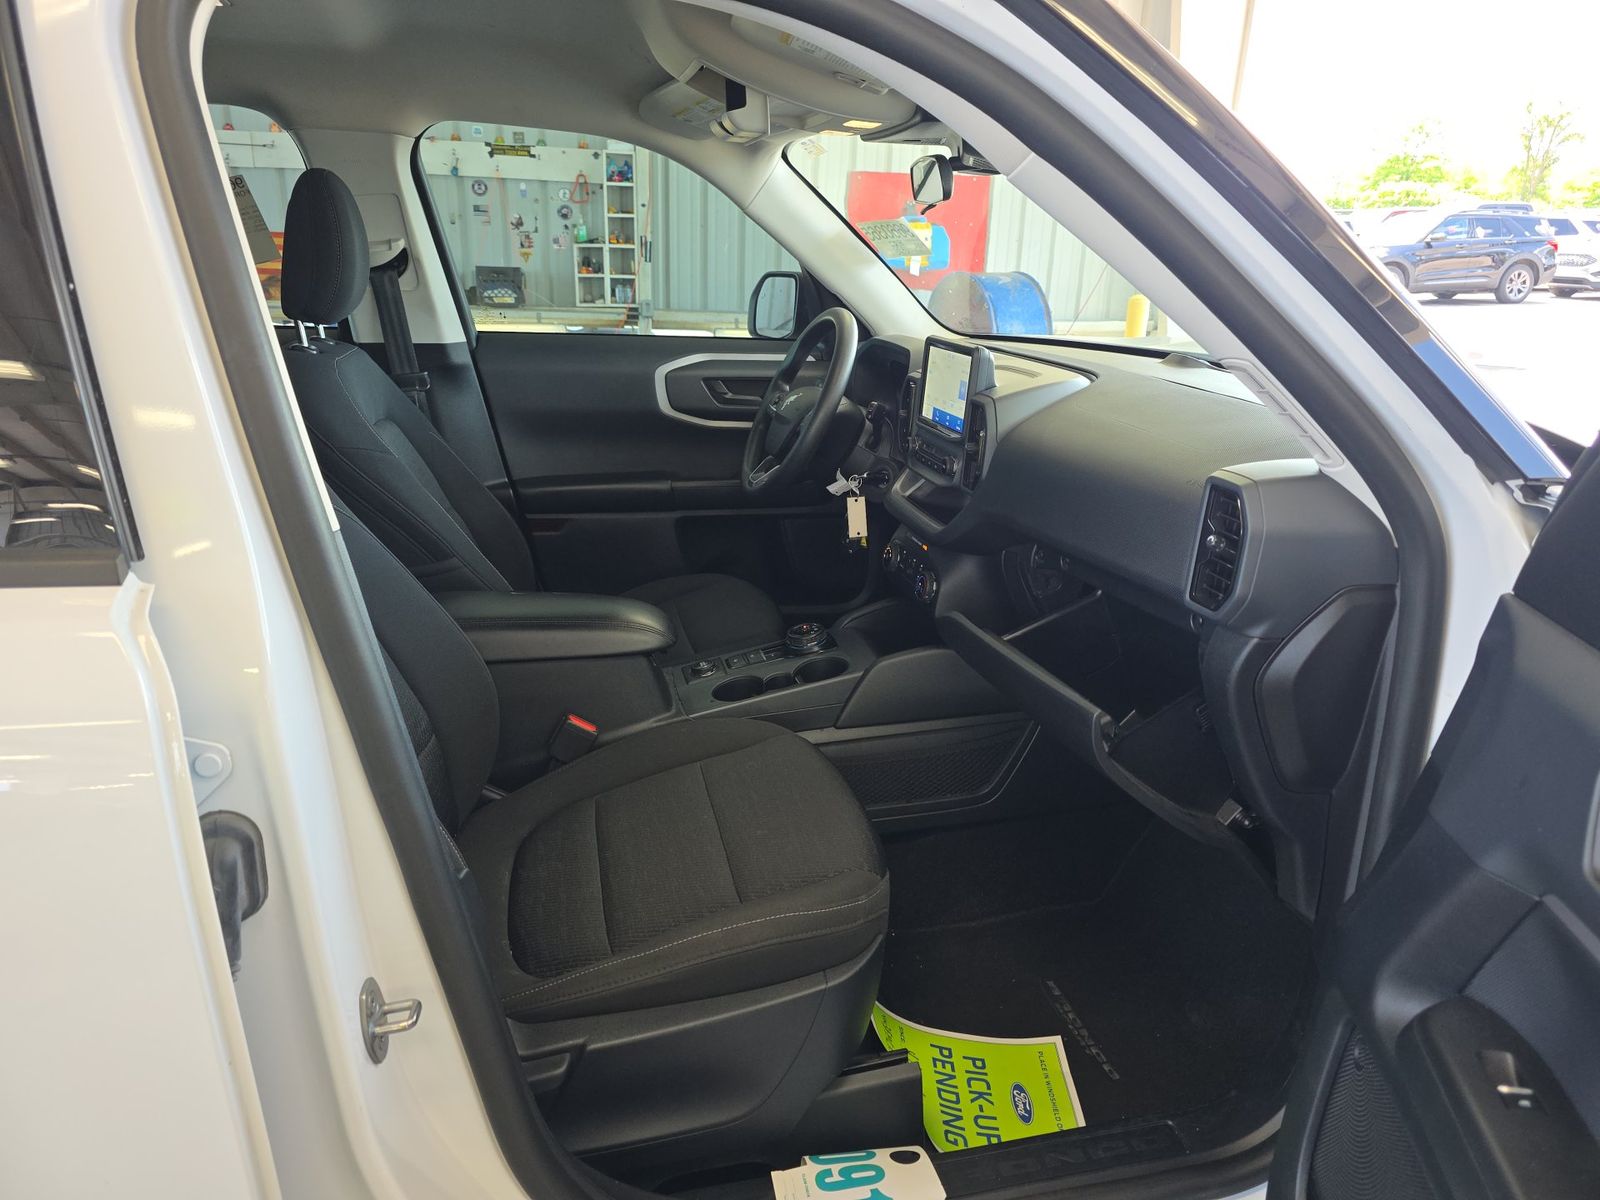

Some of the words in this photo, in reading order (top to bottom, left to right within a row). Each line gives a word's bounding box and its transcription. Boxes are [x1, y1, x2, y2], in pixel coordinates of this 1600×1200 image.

[929, 1042, 969, 1148] PENDING
[1012, 1088, 1033, 1123] Ford
[1037, 1050, 1048, 1072] PLACE
[1044, 1080, 1061, 1123] WINDSHIELD
